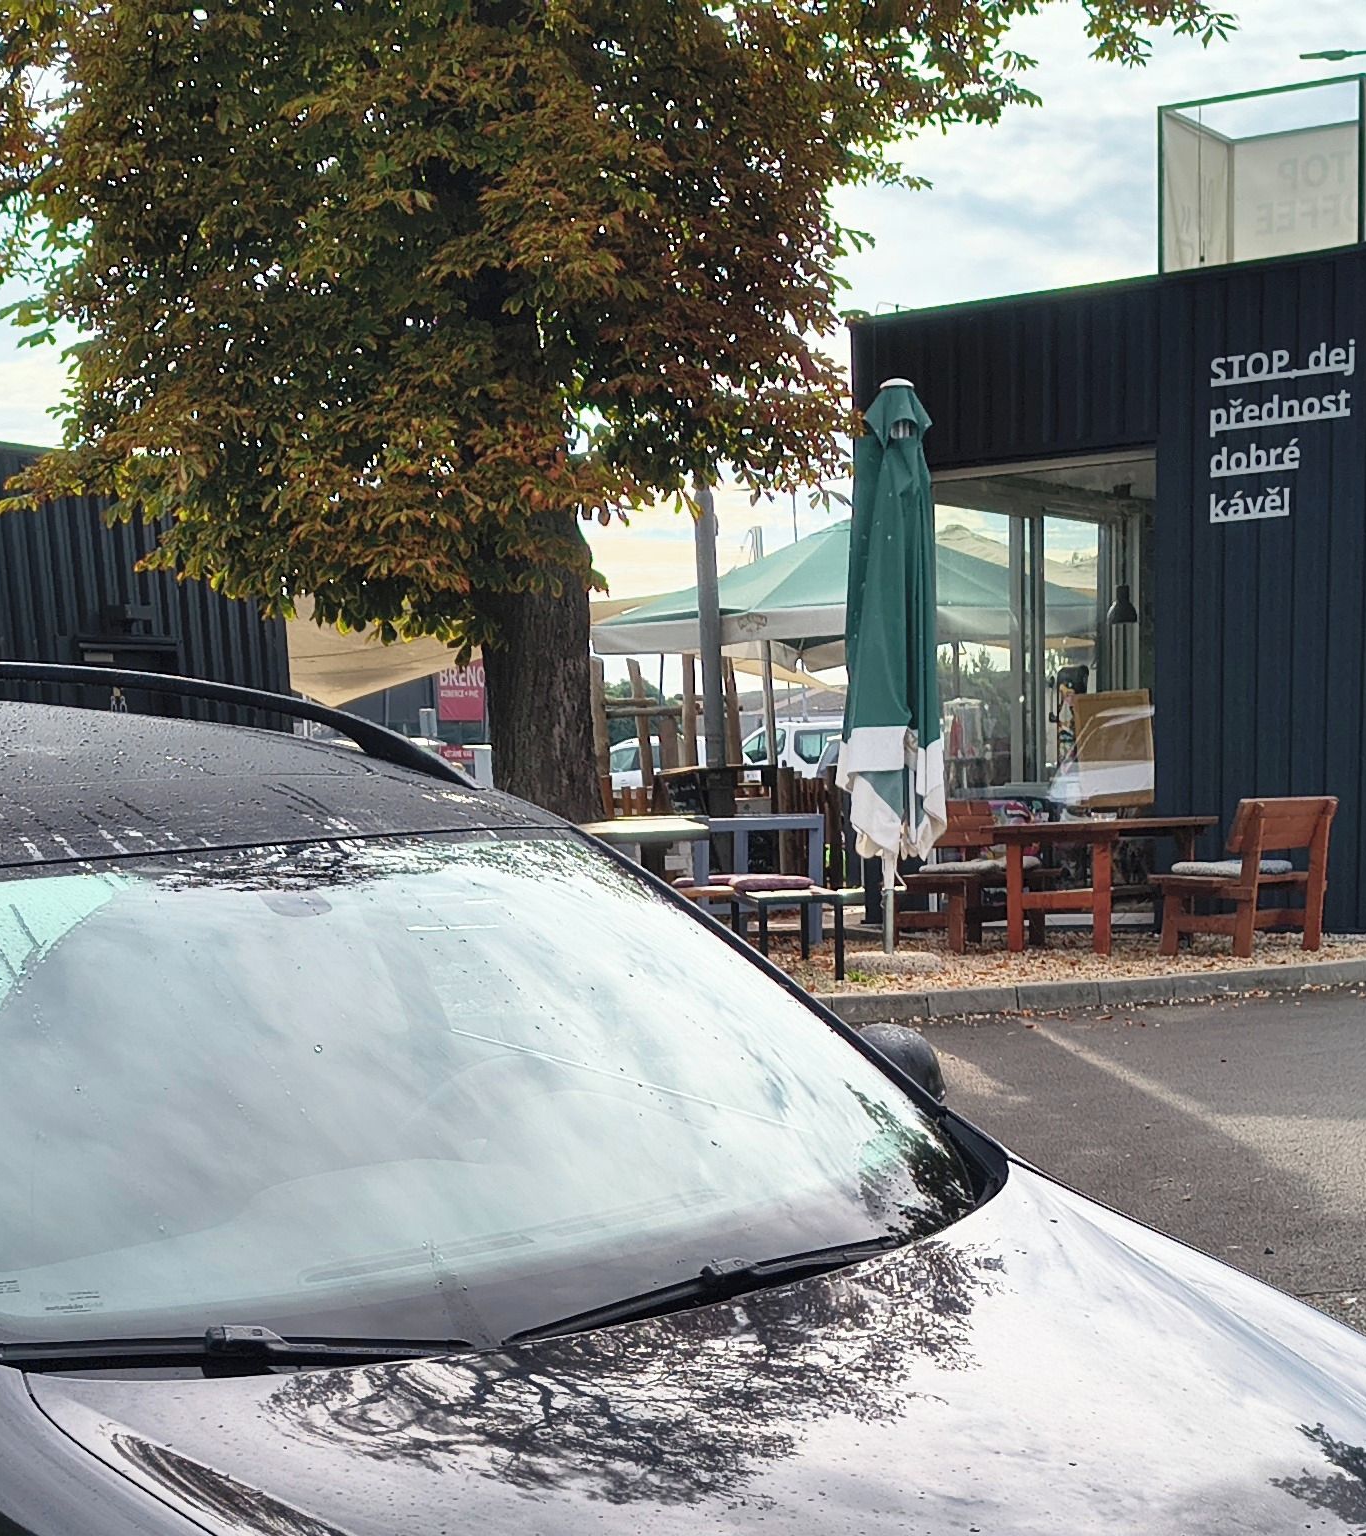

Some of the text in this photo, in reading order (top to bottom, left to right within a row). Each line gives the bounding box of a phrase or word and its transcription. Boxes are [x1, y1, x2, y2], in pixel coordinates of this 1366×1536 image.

[1308, 339, 1355, 376] dej
[1210, 389, 1351, 438] přednost
[1210, 437, 1300, 478] dobré
